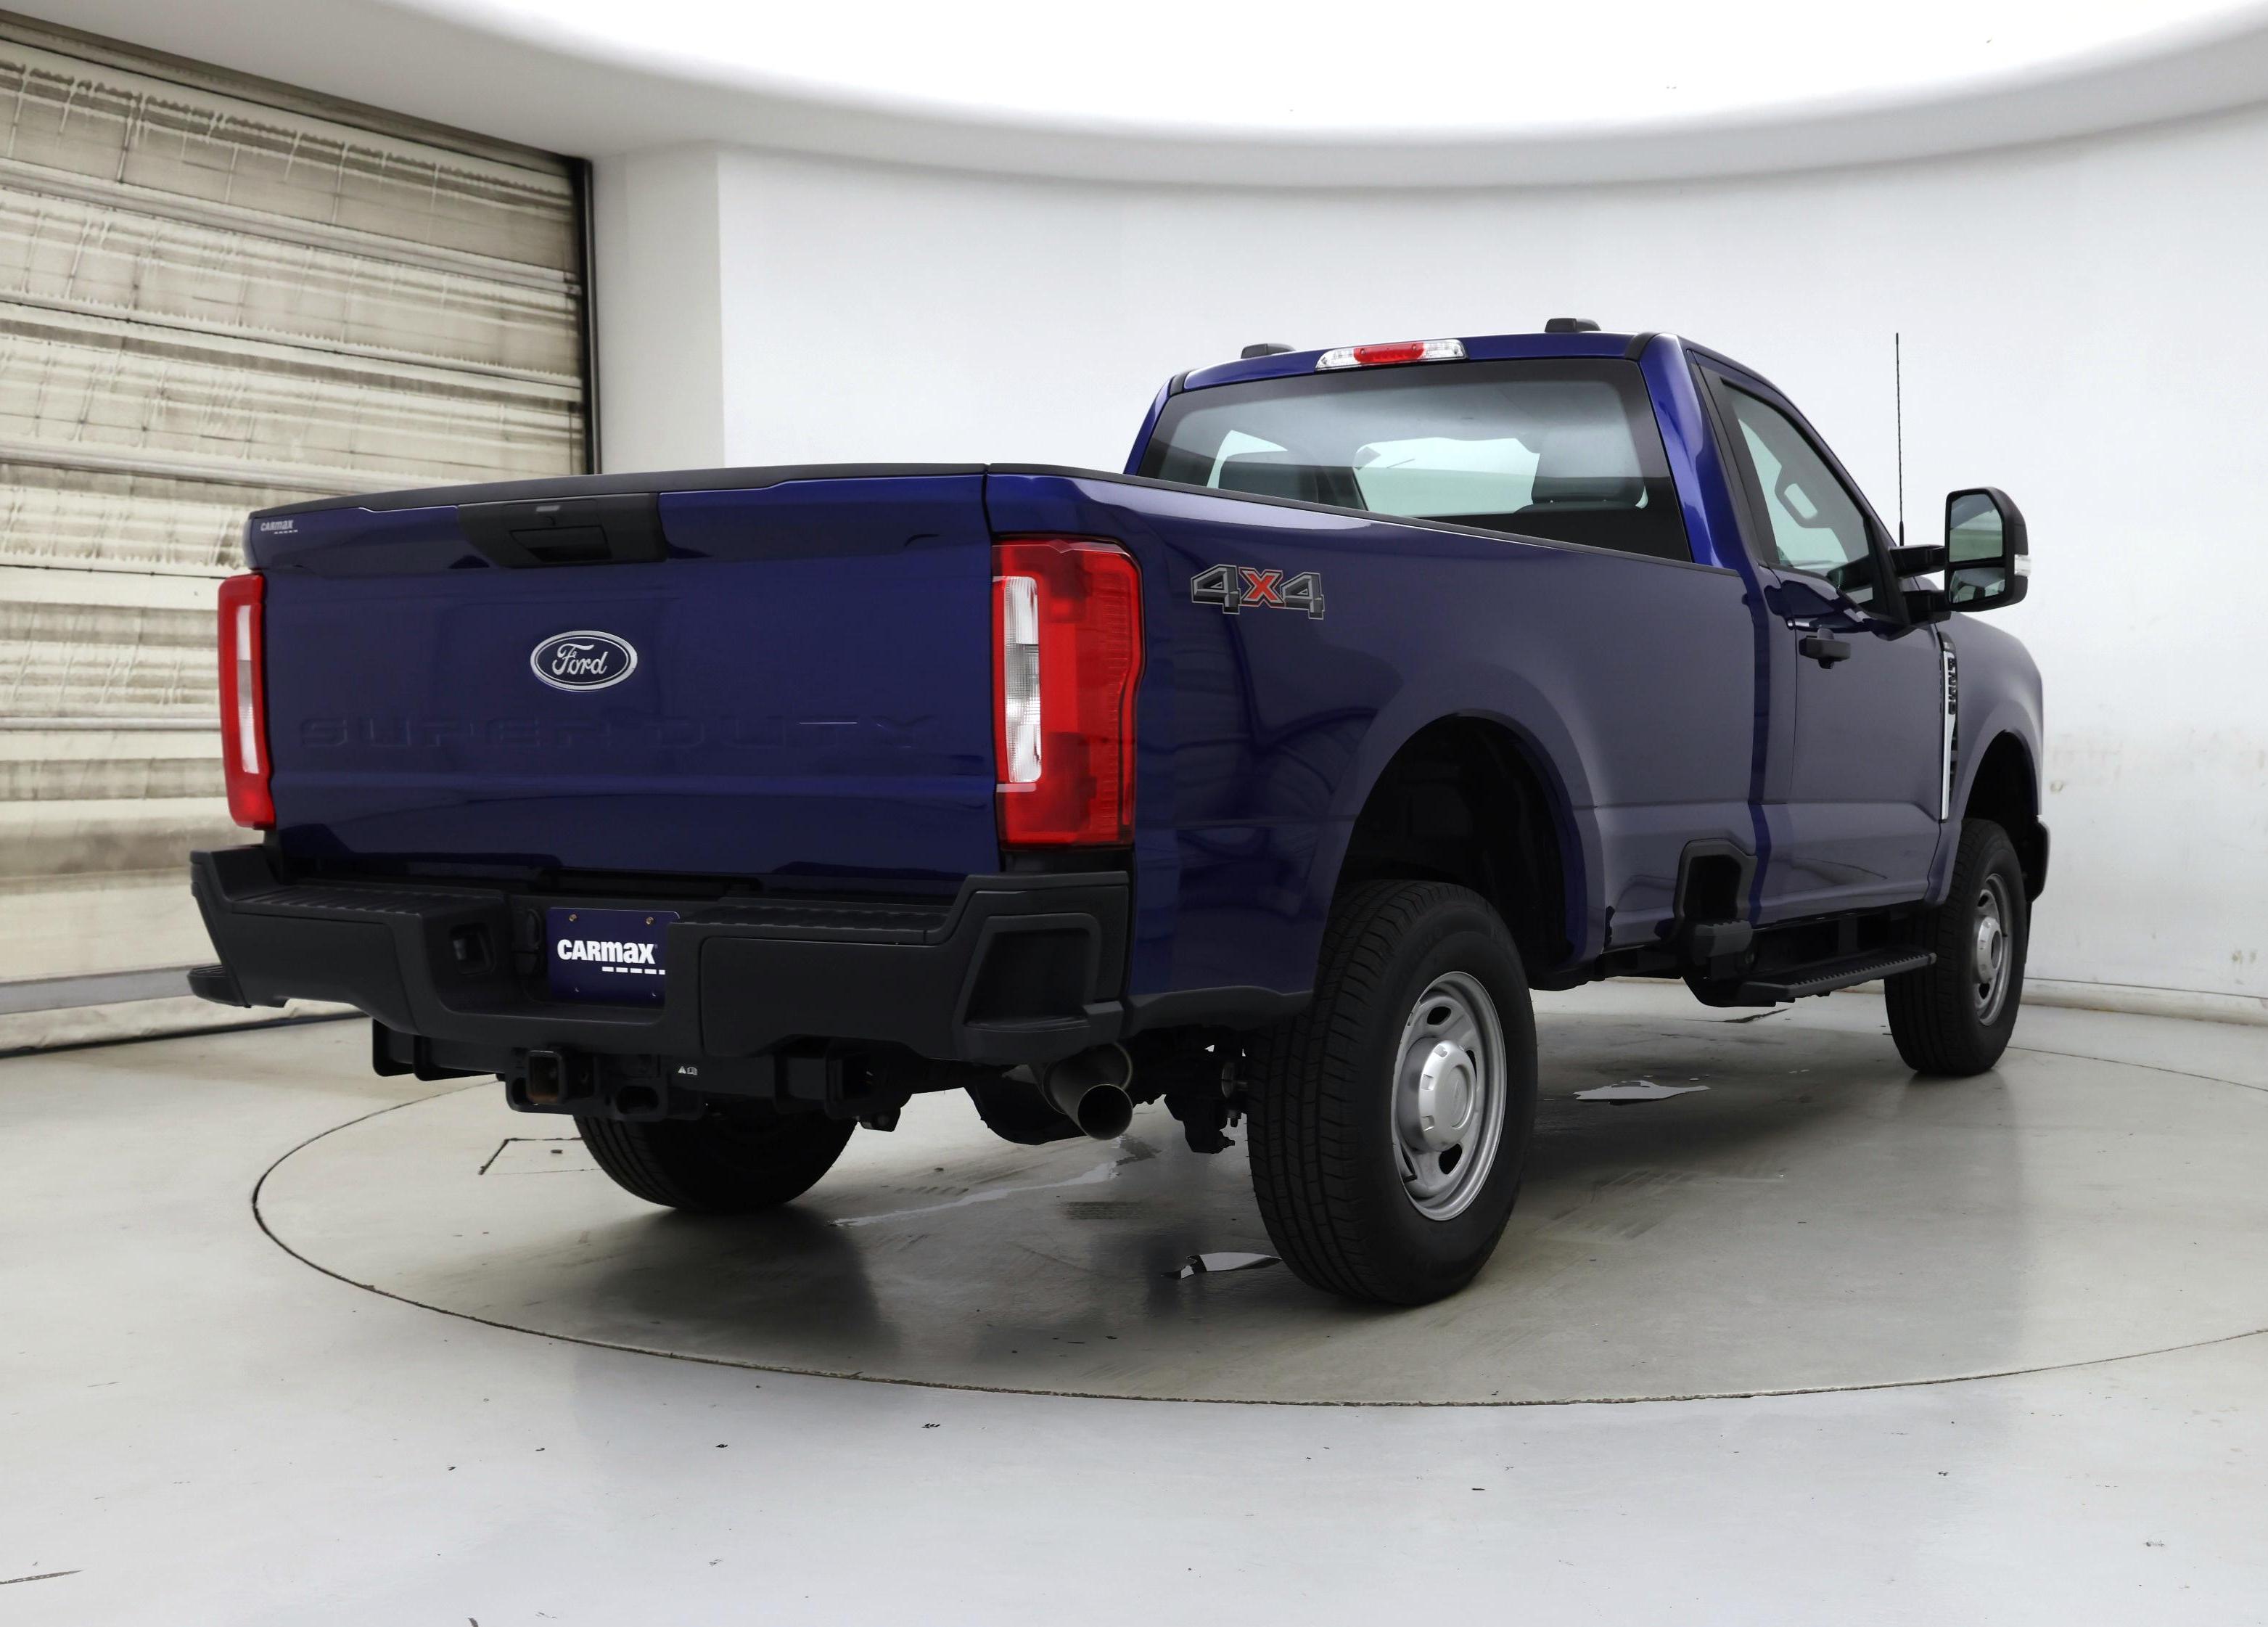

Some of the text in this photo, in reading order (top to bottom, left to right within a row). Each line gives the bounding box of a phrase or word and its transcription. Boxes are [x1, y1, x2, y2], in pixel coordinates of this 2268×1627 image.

[552, 643, 609, 675] Ford
[298, 715, 934, 747] SUPER DUTY
